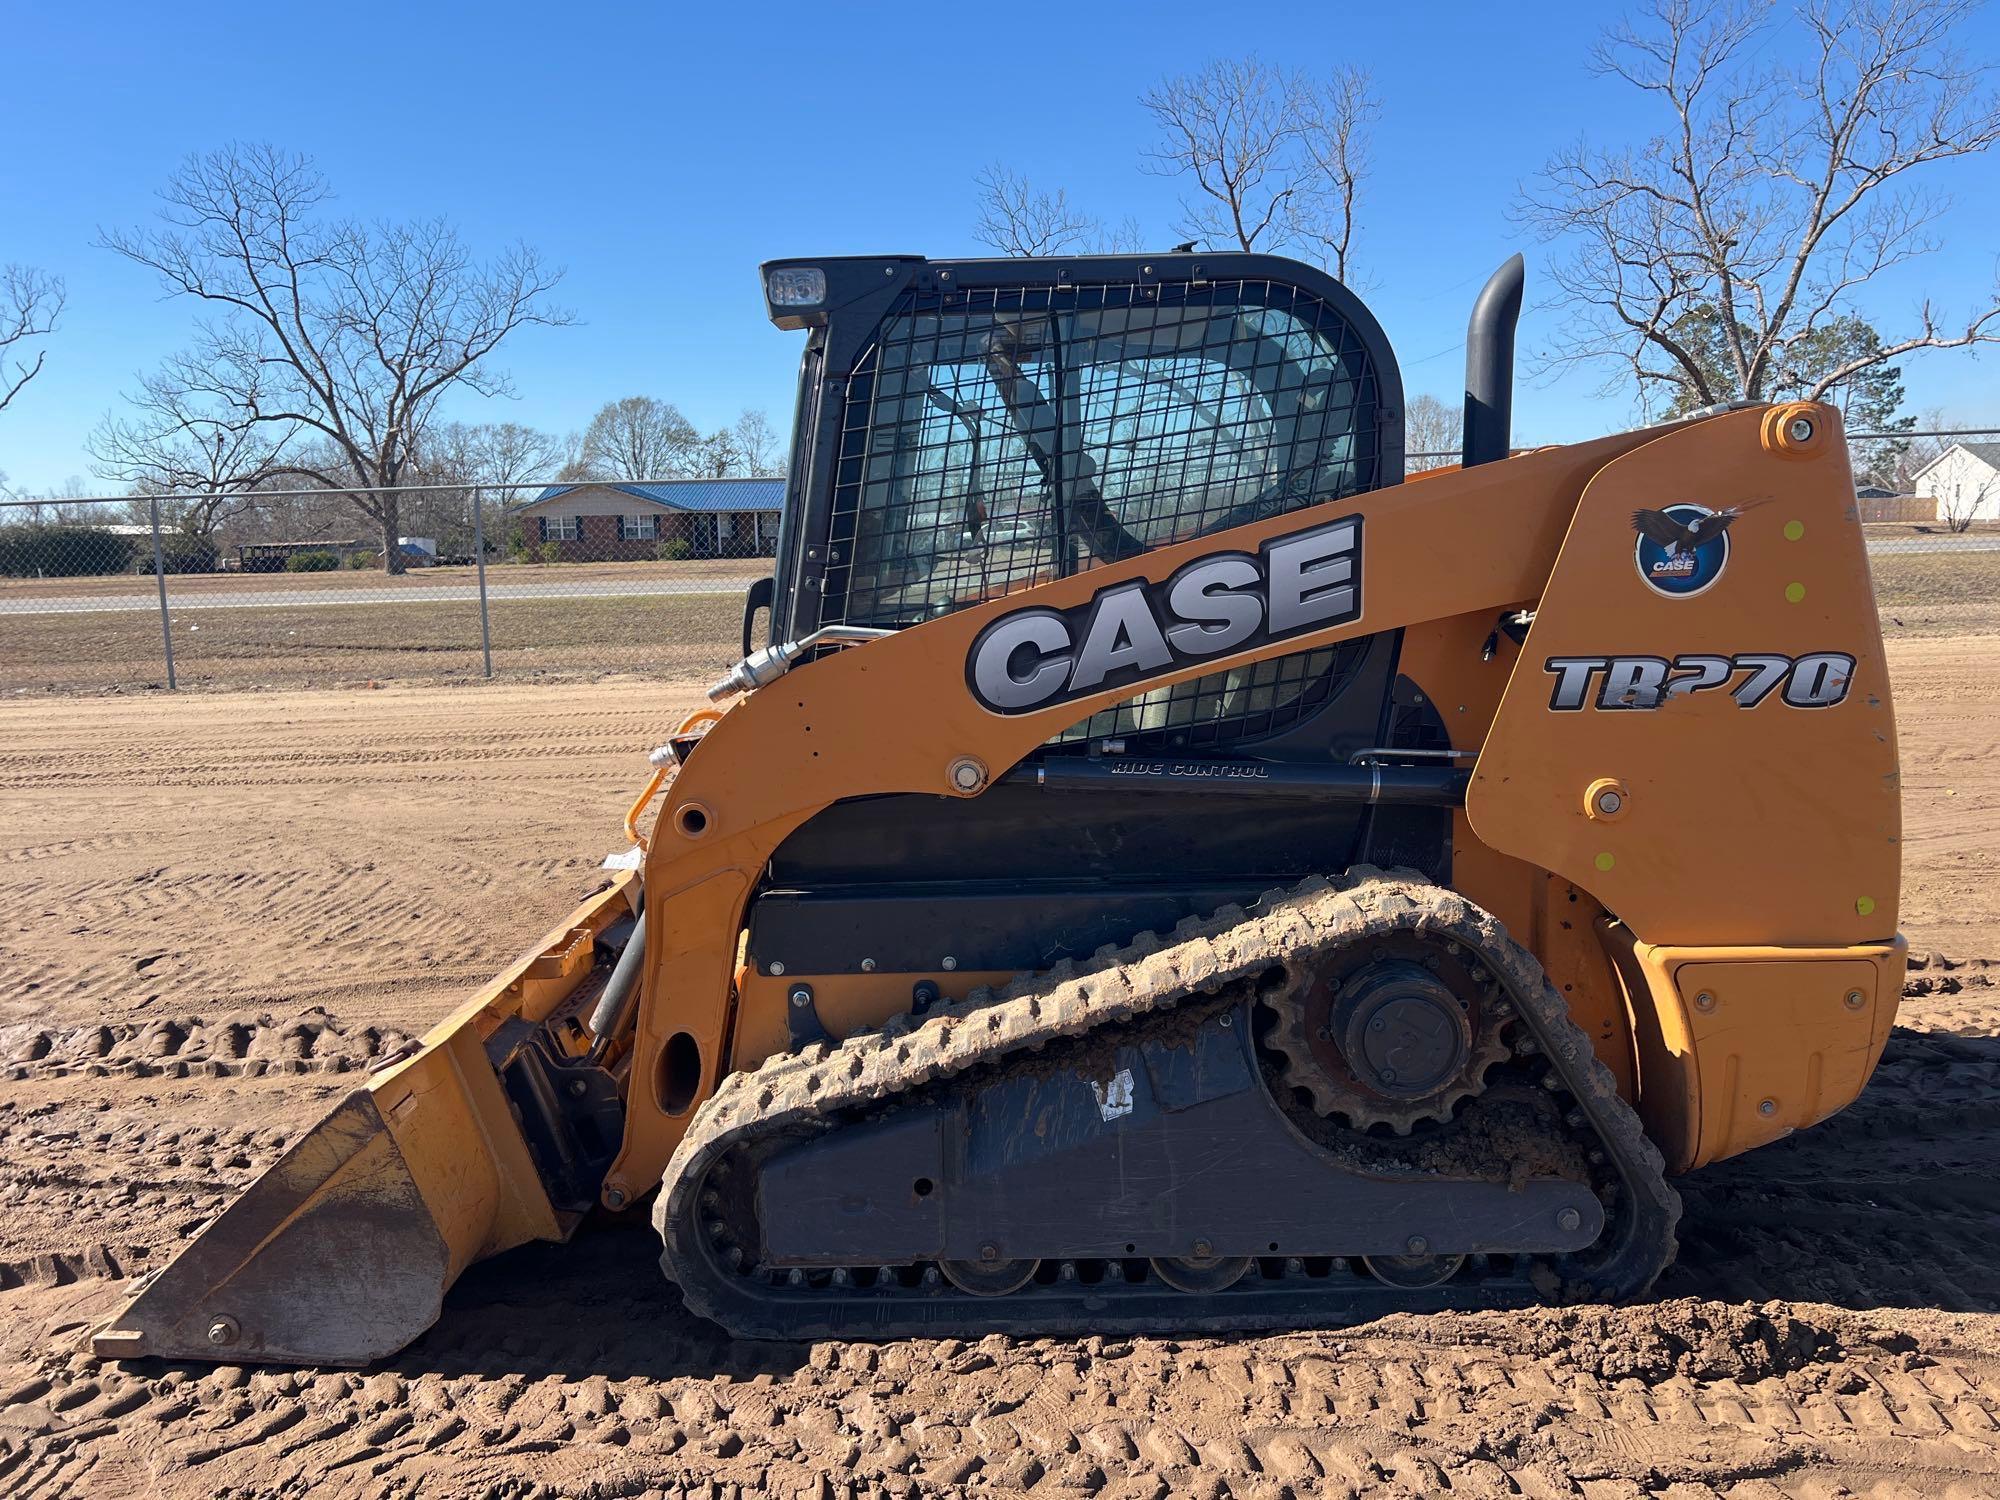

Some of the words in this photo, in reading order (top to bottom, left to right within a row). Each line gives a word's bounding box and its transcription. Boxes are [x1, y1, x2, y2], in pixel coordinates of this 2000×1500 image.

[1652, 560, 1695, 572] CASE
[973, 523, 1357, 709] CASE
[1546, 652, 1856, 711] TR270
[1111, 761, 1164, 775] RIDE
[1168, 763, 1269, 778] CONTROL
